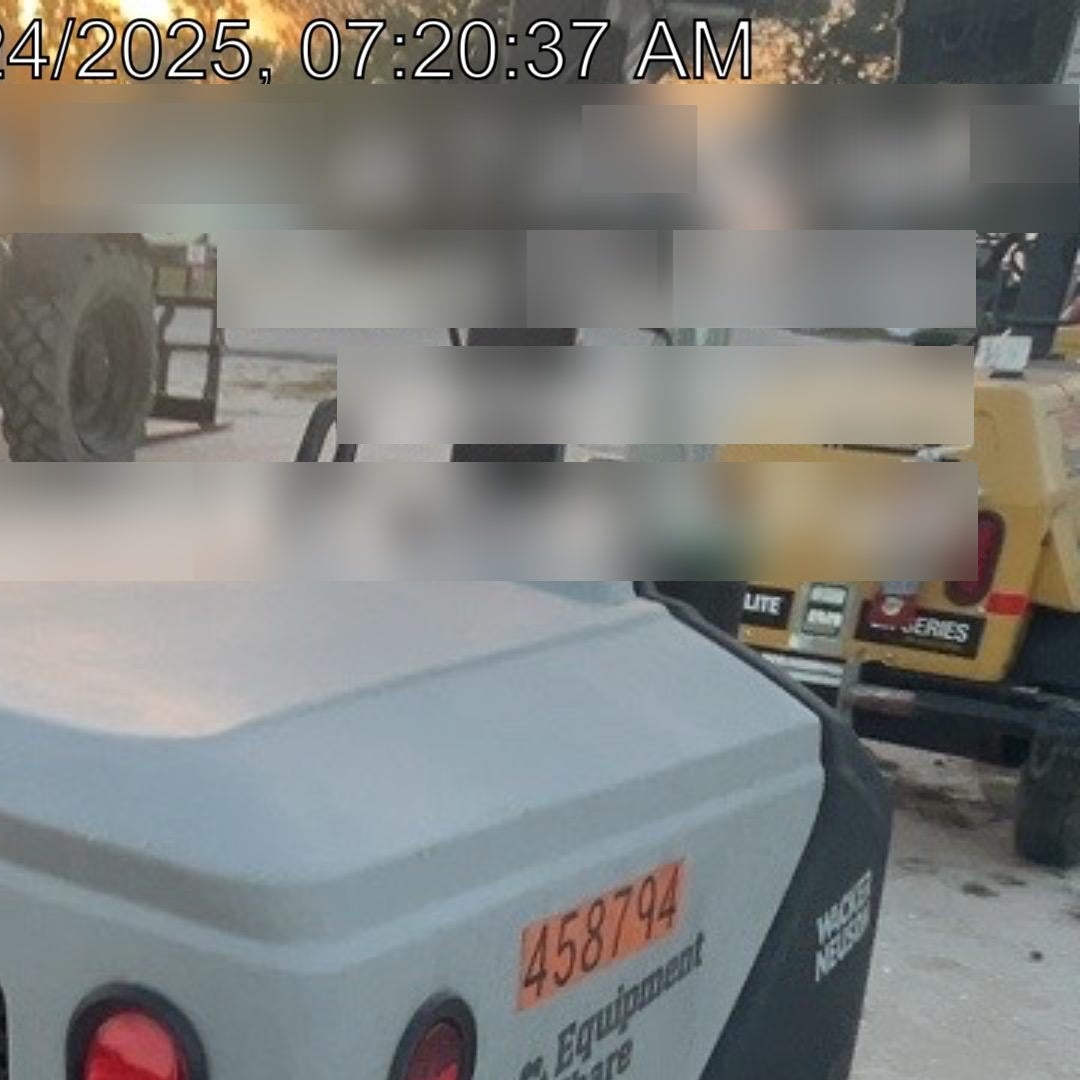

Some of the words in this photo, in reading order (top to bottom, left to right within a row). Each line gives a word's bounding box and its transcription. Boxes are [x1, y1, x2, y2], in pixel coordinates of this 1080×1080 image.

[742, 592, 783, 616] LITE
[522, 862, 682, 998] 458794
[554, 931, 706, 1078] Equipment
